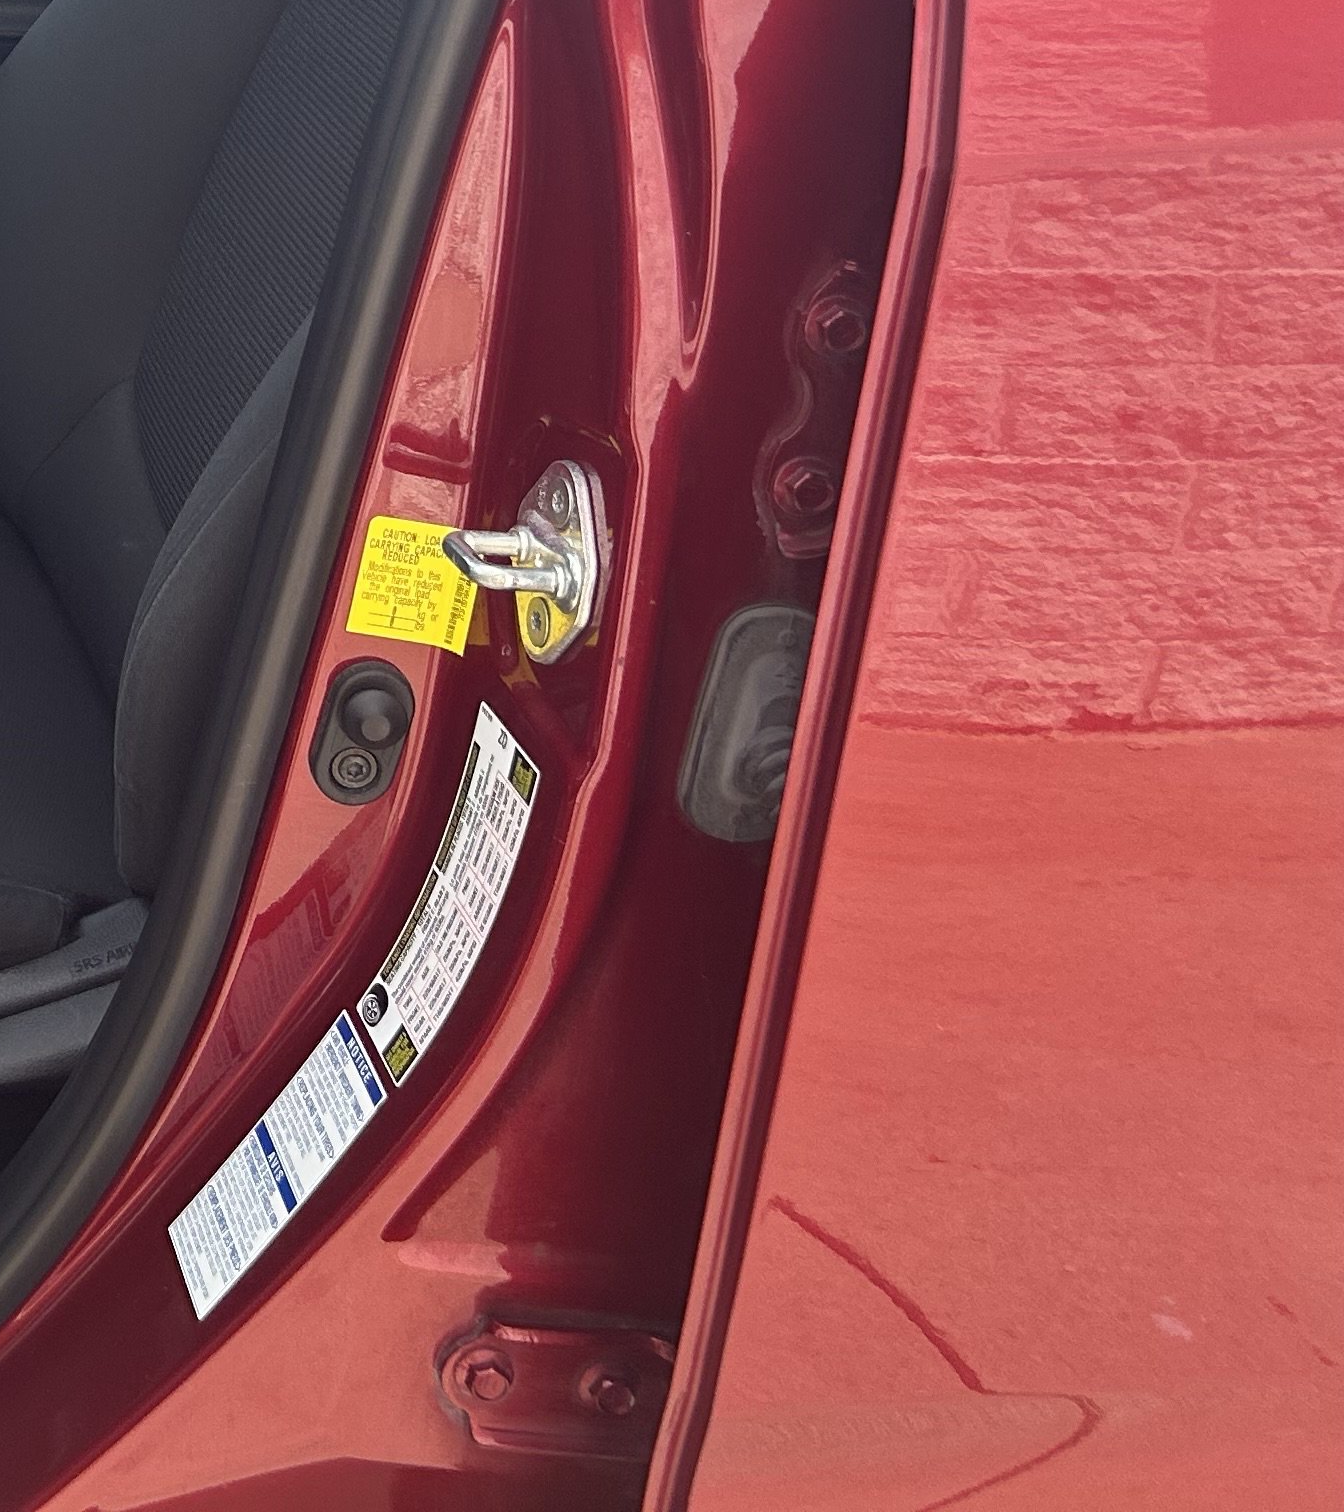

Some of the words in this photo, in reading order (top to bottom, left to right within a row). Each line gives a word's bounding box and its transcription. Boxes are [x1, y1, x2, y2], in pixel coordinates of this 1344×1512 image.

[369, 538, 411, 553] CARRYING
[415, 545, 447, 559] CAPAC
[425, 535, 442, 546] LOA
[382, 549, 420, 565] REDUCED
[347, 1037, 372, 1085] NOTICE
[297, 1079, 316, 1116] REPLACING
[312, 1112, 325, 1135] YOUR
[320, 1131, 333, 1155] TIRES
[267, 1151, 285, 1182] AVIS
